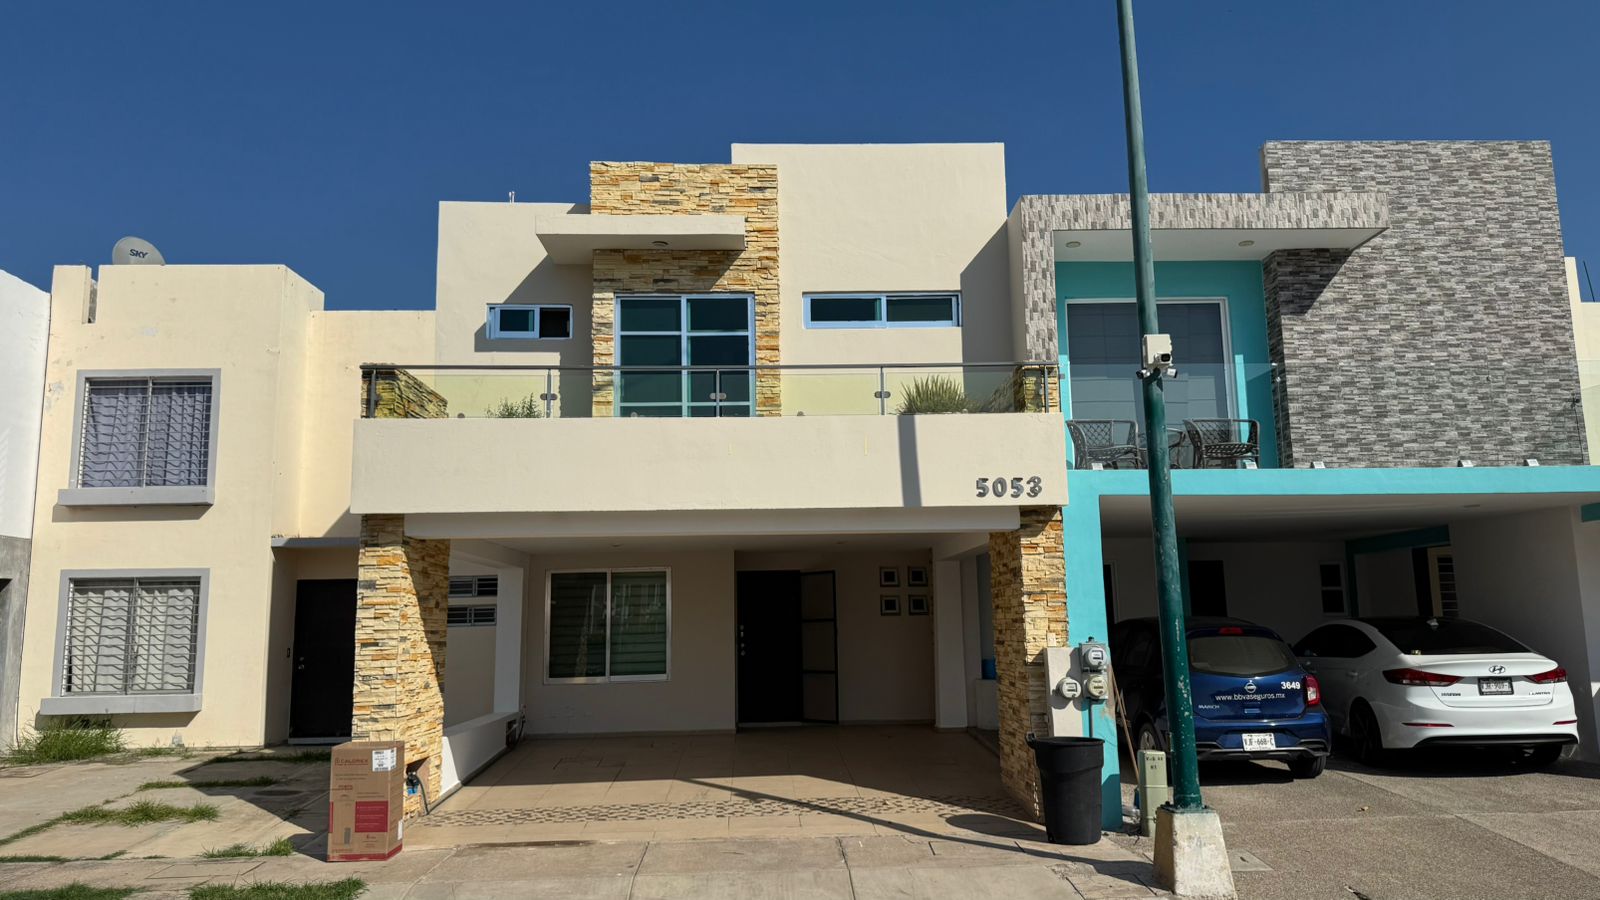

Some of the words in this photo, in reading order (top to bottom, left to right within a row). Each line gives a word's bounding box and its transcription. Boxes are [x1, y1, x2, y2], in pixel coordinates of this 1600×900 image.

[129, 248, 148, 258] SKY
[976, 476, 1042, 498] 5053
[1281, 681, 1301, 690] 3649
[1215, 692, 1286, 701] www.bbvaseguros.mx
